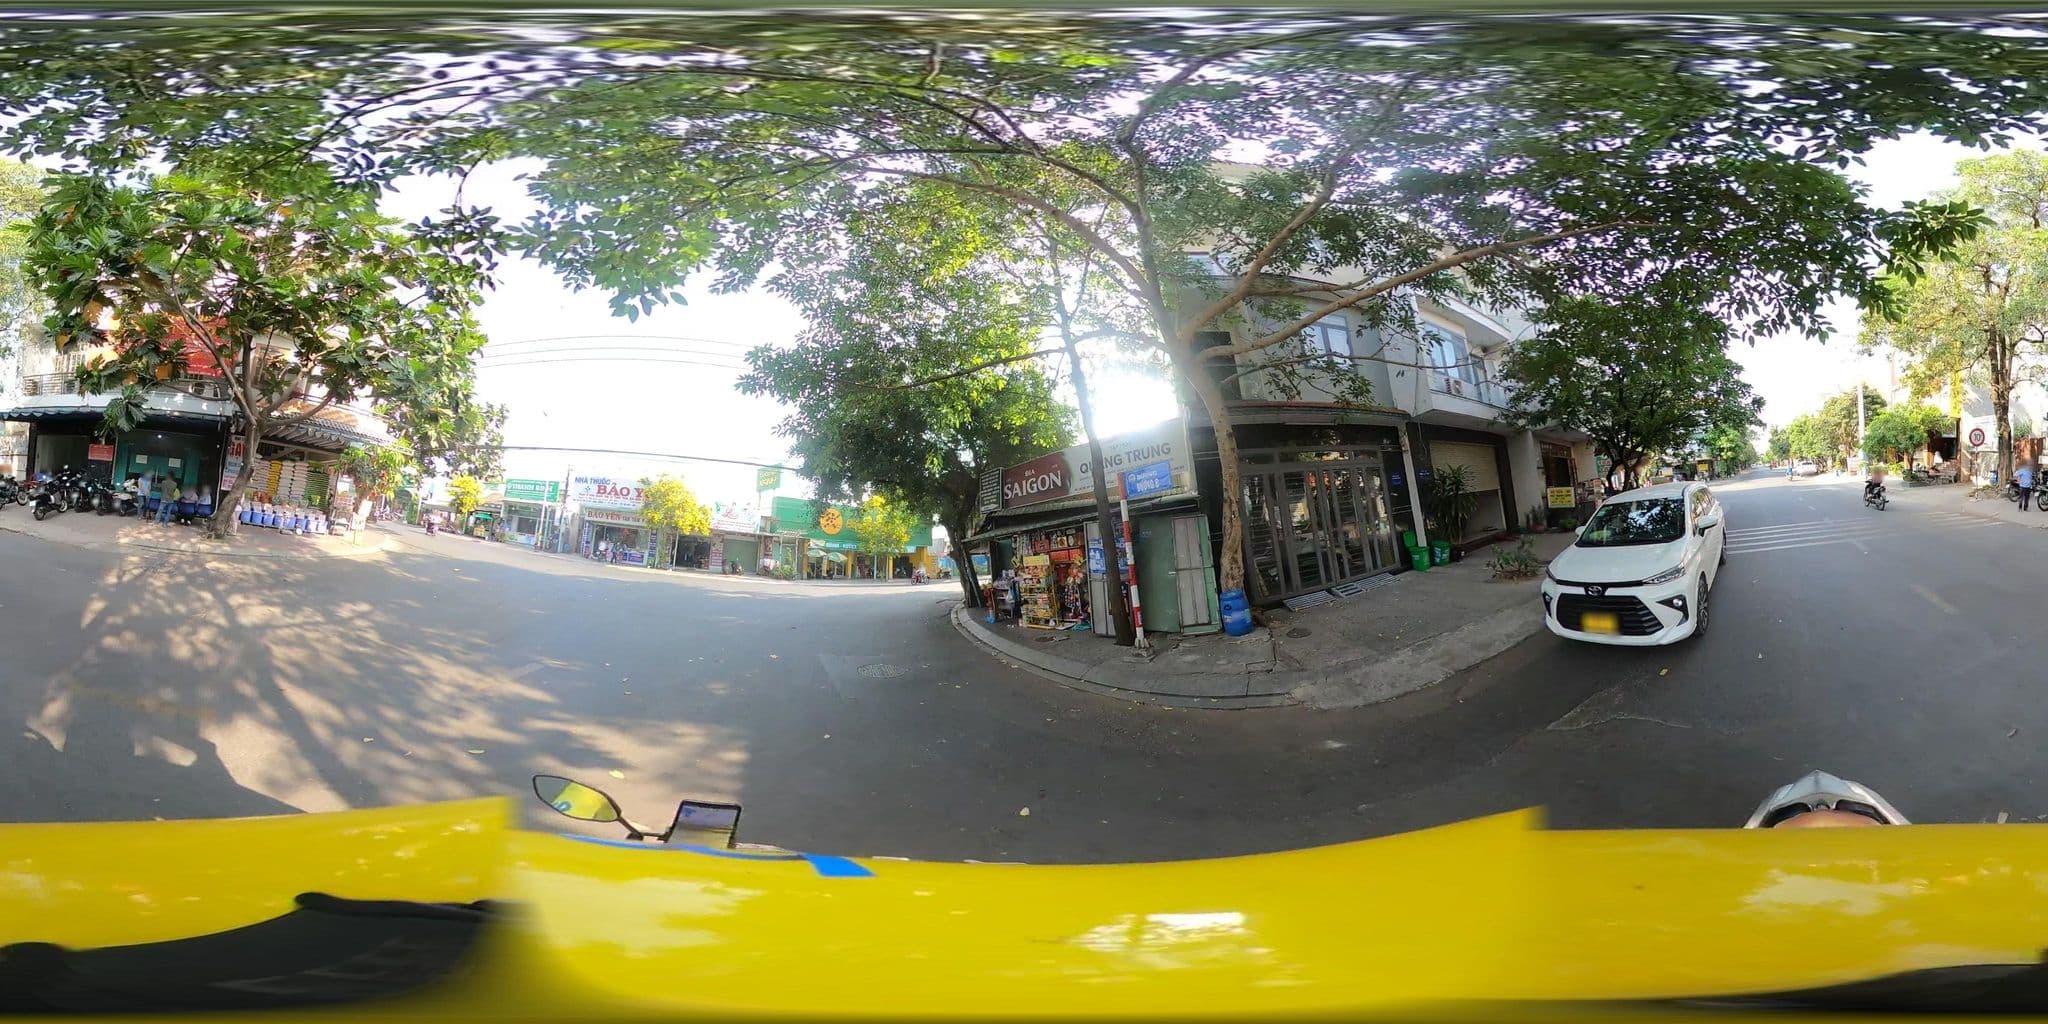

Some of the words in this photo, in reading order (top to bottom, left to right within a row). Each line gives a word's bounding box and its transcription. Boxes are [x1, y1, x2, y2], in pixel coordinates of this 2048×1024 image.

[1974, 432, 1981, 442] 10
[1080, 454, 1123, 474] QUNG
[1125, 442, 1171, 463] TRUNG
[596, 482, 630, 497] BẢO
[1004, 470, 1062, 499] SAIGON
